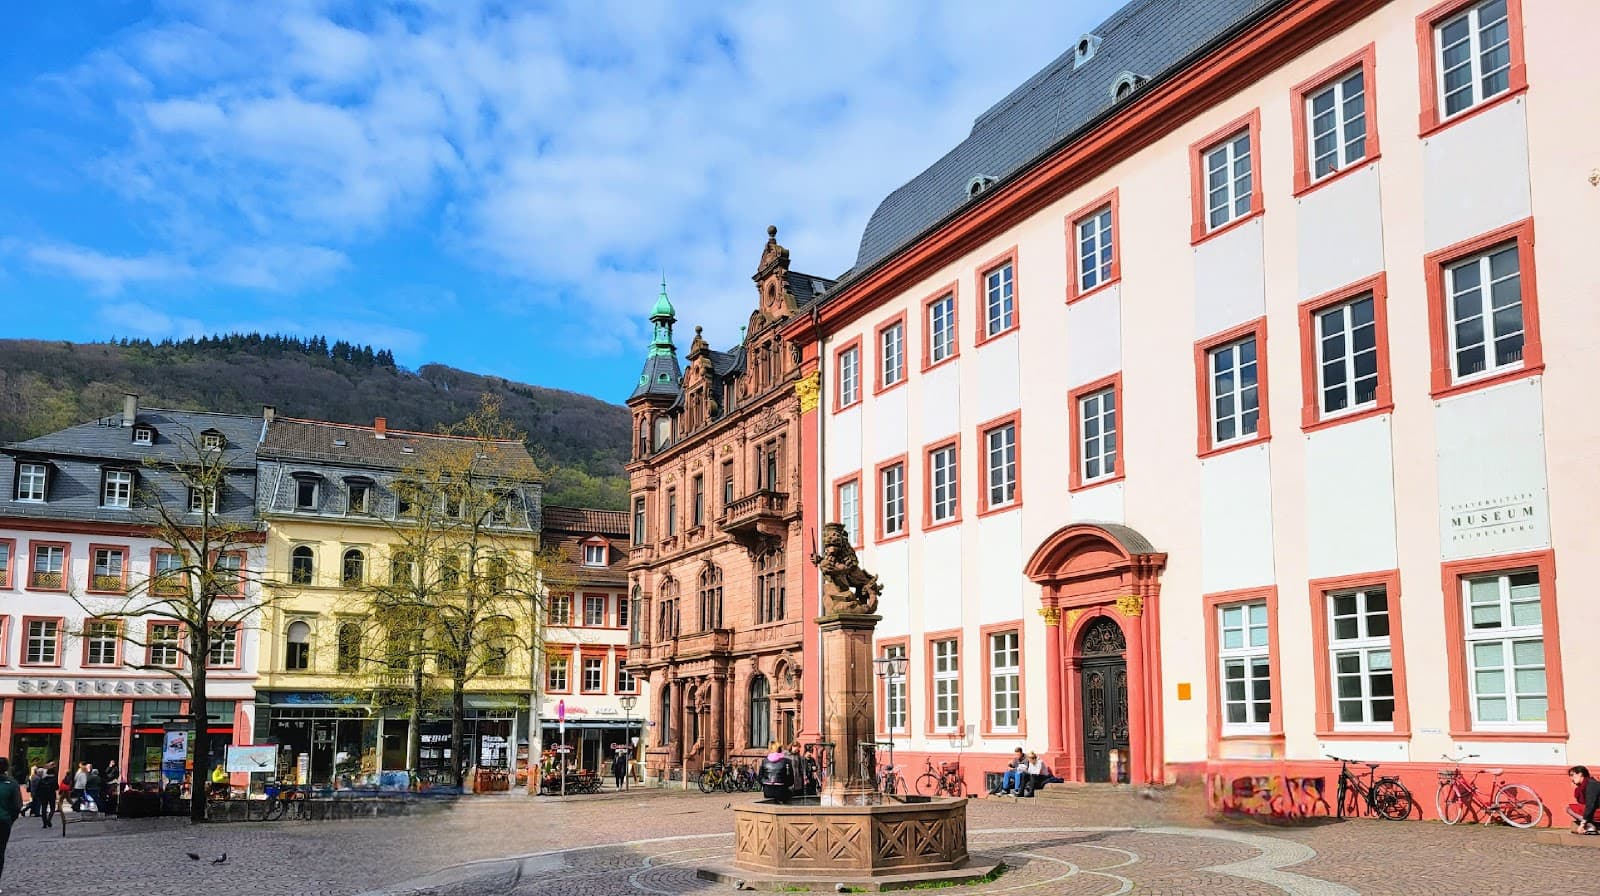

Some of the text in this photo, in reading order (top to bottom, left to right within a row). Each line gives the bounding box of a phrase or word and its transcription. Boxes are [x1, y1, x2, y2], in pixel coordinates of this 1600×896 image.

[1451, 506, 1533, 526] MUSEUM
[1453, 525, 1533, 540] HEIDELBERG
[17, 679, 185, 694] SPARKASSE
